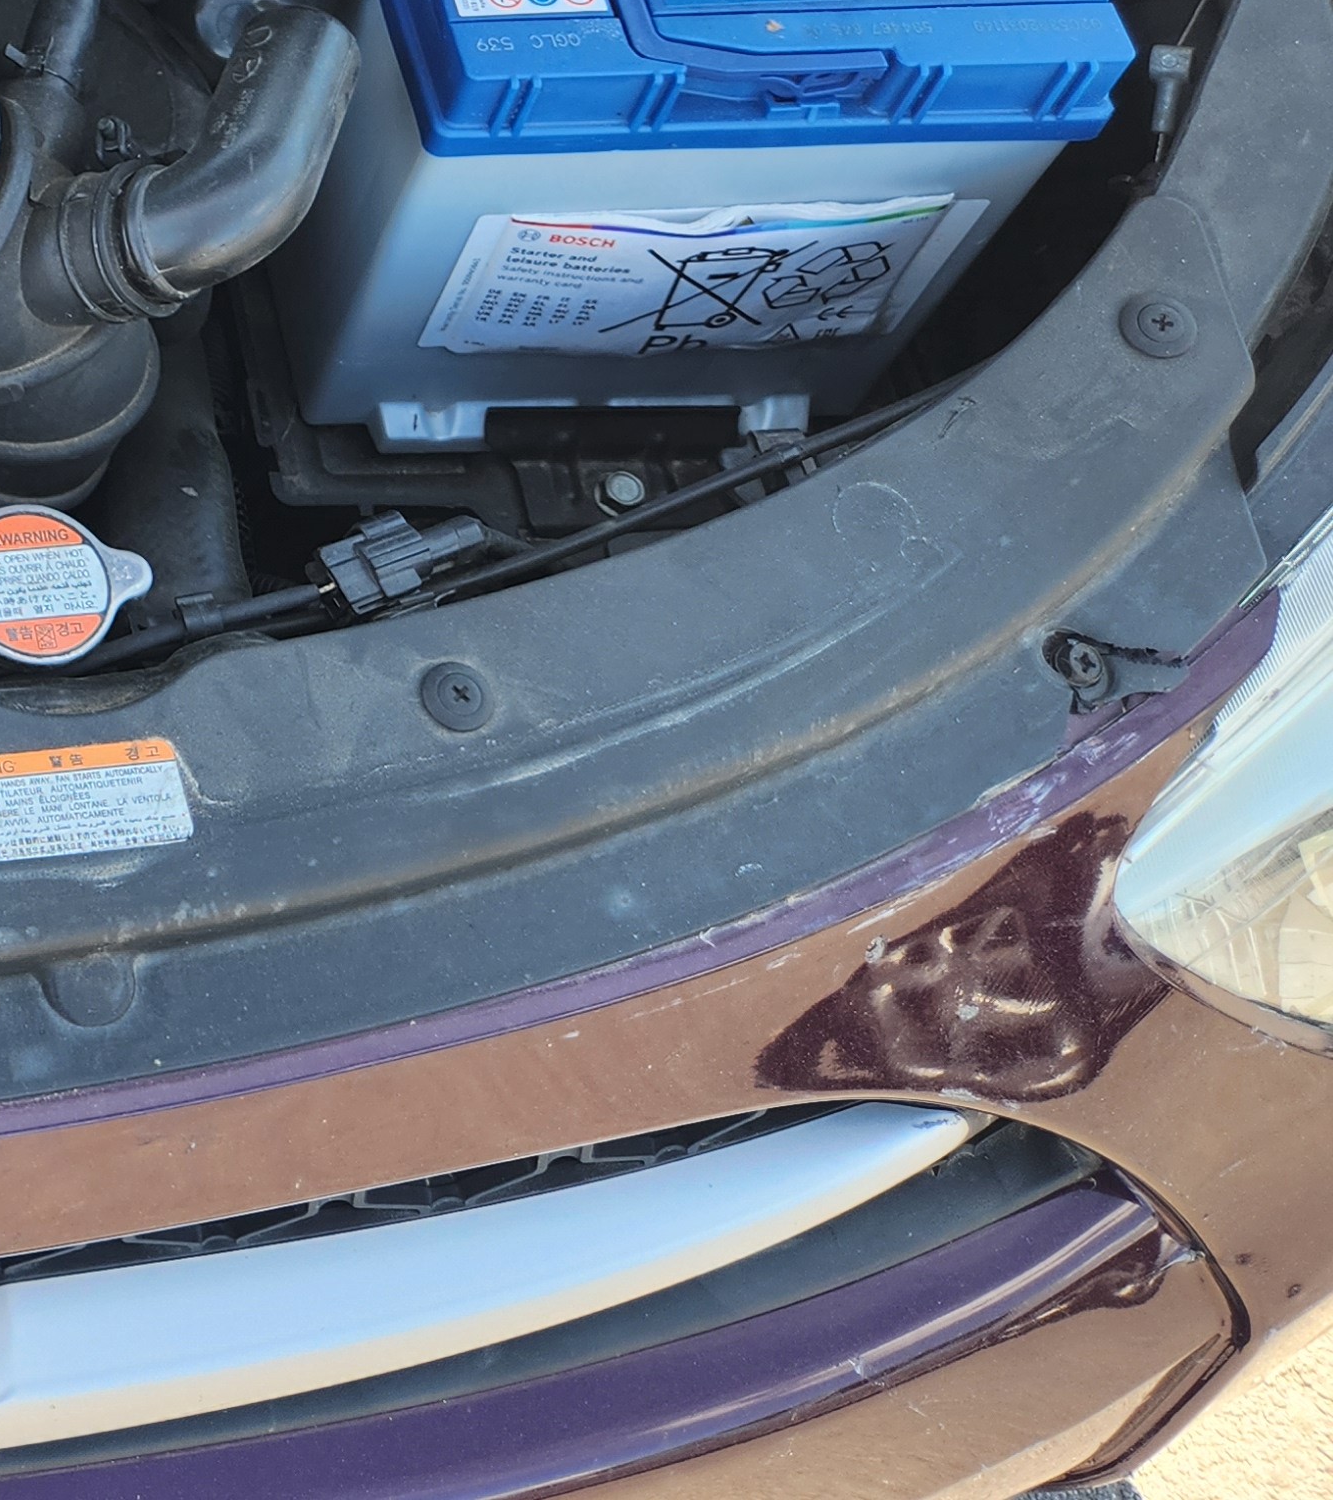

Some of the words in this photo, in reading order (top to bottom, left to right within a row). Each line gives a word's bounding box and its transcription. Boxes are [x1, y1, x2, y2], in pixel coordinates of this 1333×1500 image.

[476, 36, 515, 52] 539
[549, 234, 615, 248] BOSCH
[510, 247, 565, 259] Starter
[501, 264, 539, 275] Safety
[543, 270, 616, 282] instructions
[563, 262, 631, 274] batteries
[497, 274, 550, 286] warranty
[553, 280, 583, 289] card
[638, 334, 708, 354] Pb
[0, 528, 69, 546] WARNING
[3, 553, 29, 564] OPEN
[32, 550, 61, 561] WHEN
[8, 562, 43, 575] OUVRIR
[25, 572, 61, 584] QUANDO
[56, 622, 85, 637] 경고
[125, 744, 161, 761] 경고
[1, 779, 27, 789] HANDS
[54, 774, 71, 784] FAN
[73, 770, 102, 782] STARTS
[104, 764, 163, 778] AUTOMATICALLY
[51, 776, 144, 793] AUTOMATIQUETENIR
[5, 797, 34, 808] MAINS
[23, 806, 35, 816] LE
[41, 802, 63, 814] MANI
[117, 796, 128, 806] LA
[5, 818, 31, 828] AVVIA
[37, 808, 125, 824] AUTOMATICAMENTE
